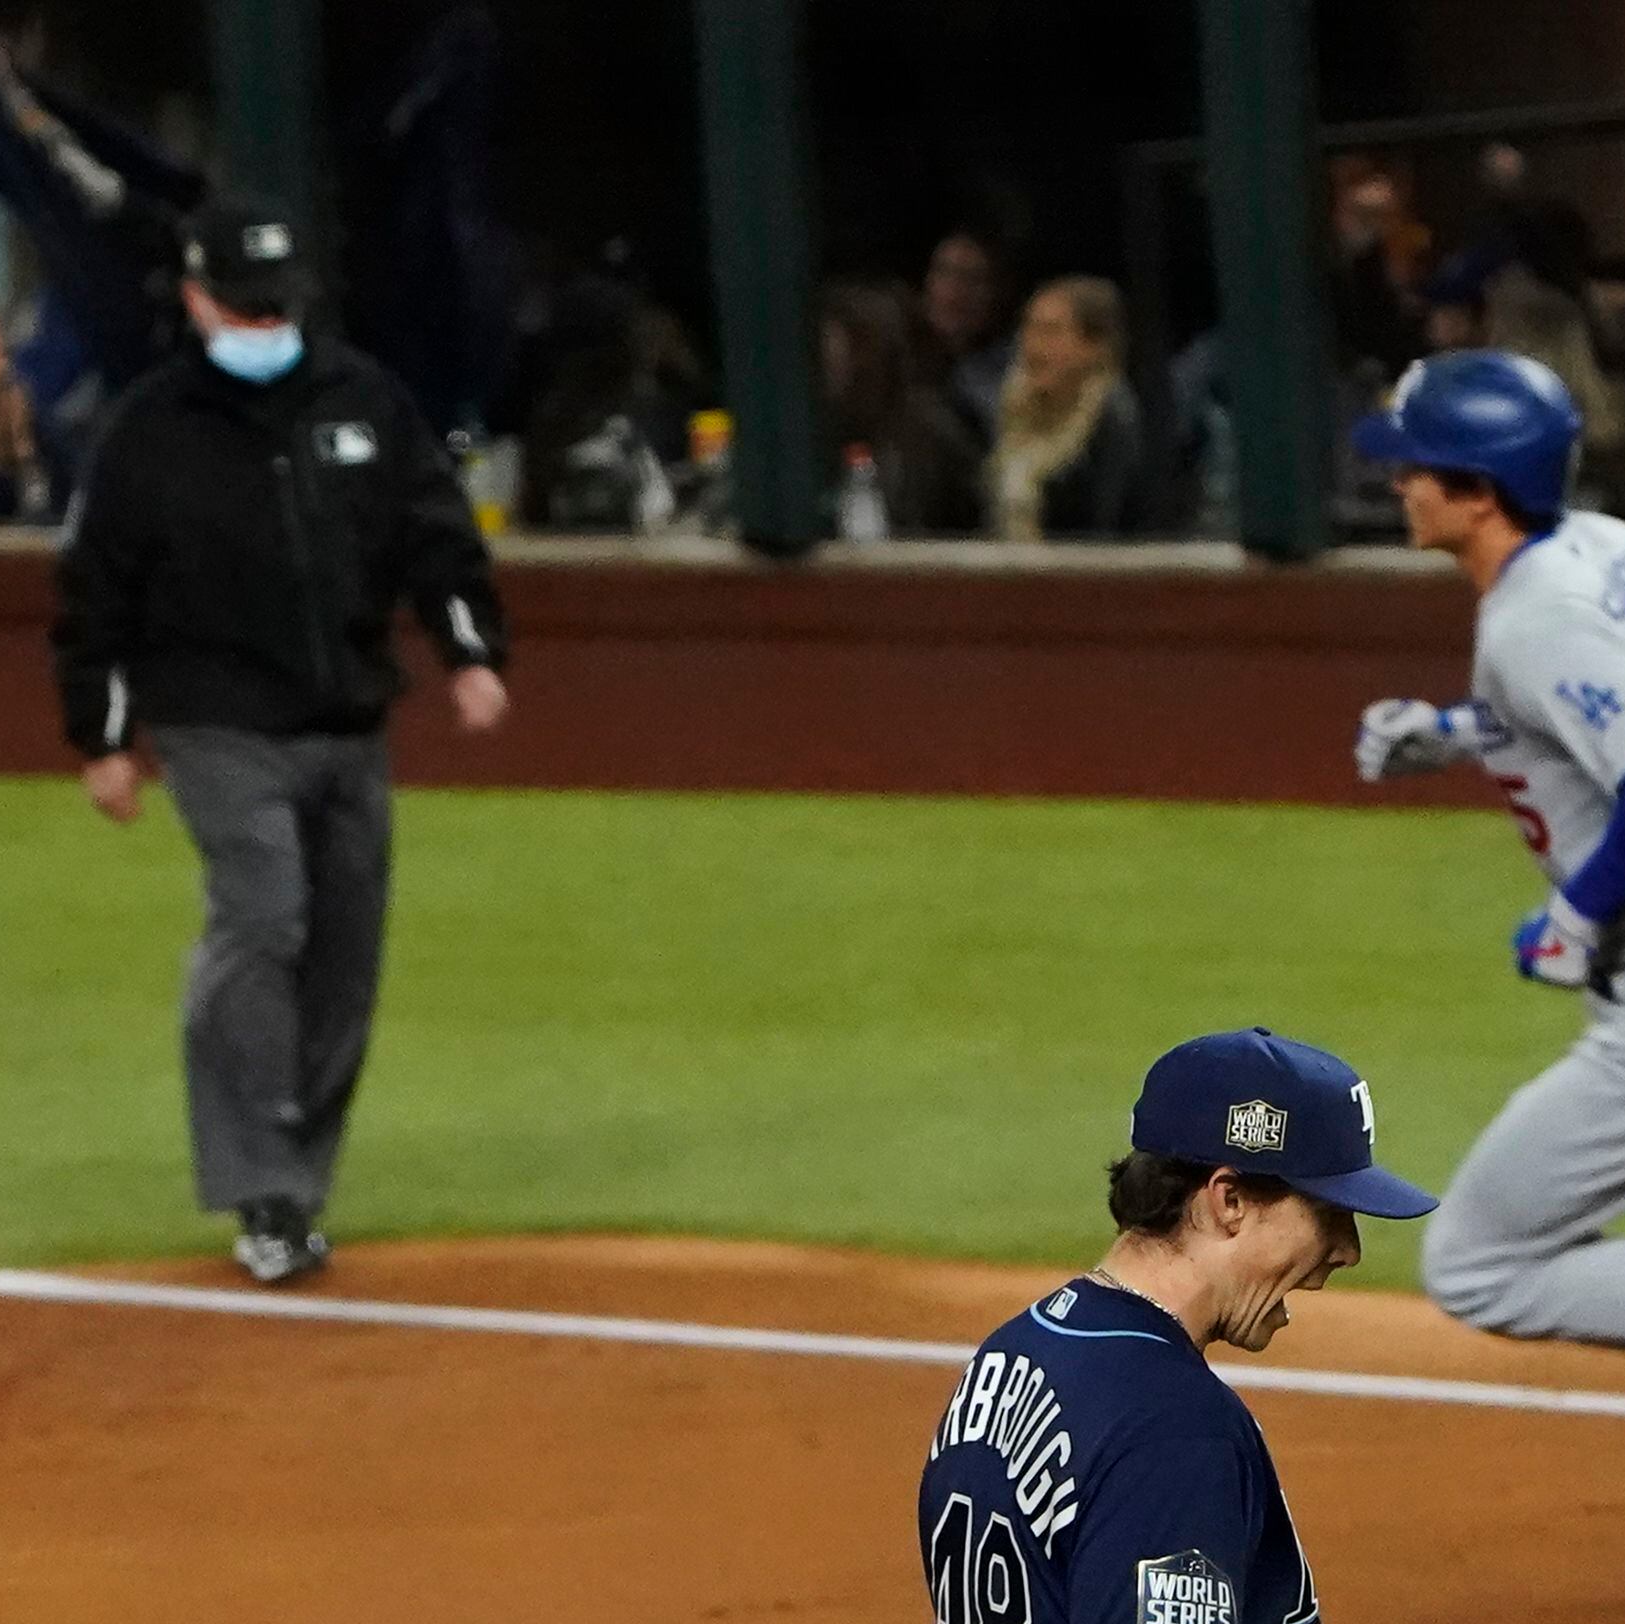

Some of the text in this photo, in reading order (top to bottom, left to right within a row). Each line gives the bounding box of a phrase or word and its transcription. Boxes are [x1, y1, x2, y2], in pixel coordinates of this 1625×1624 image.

[1233, 1109, 1282, 1130] WORLD
[1230, 1125, 1281, 1143] SERIES
[1148, 1571, 1230, 1608] WORLD
